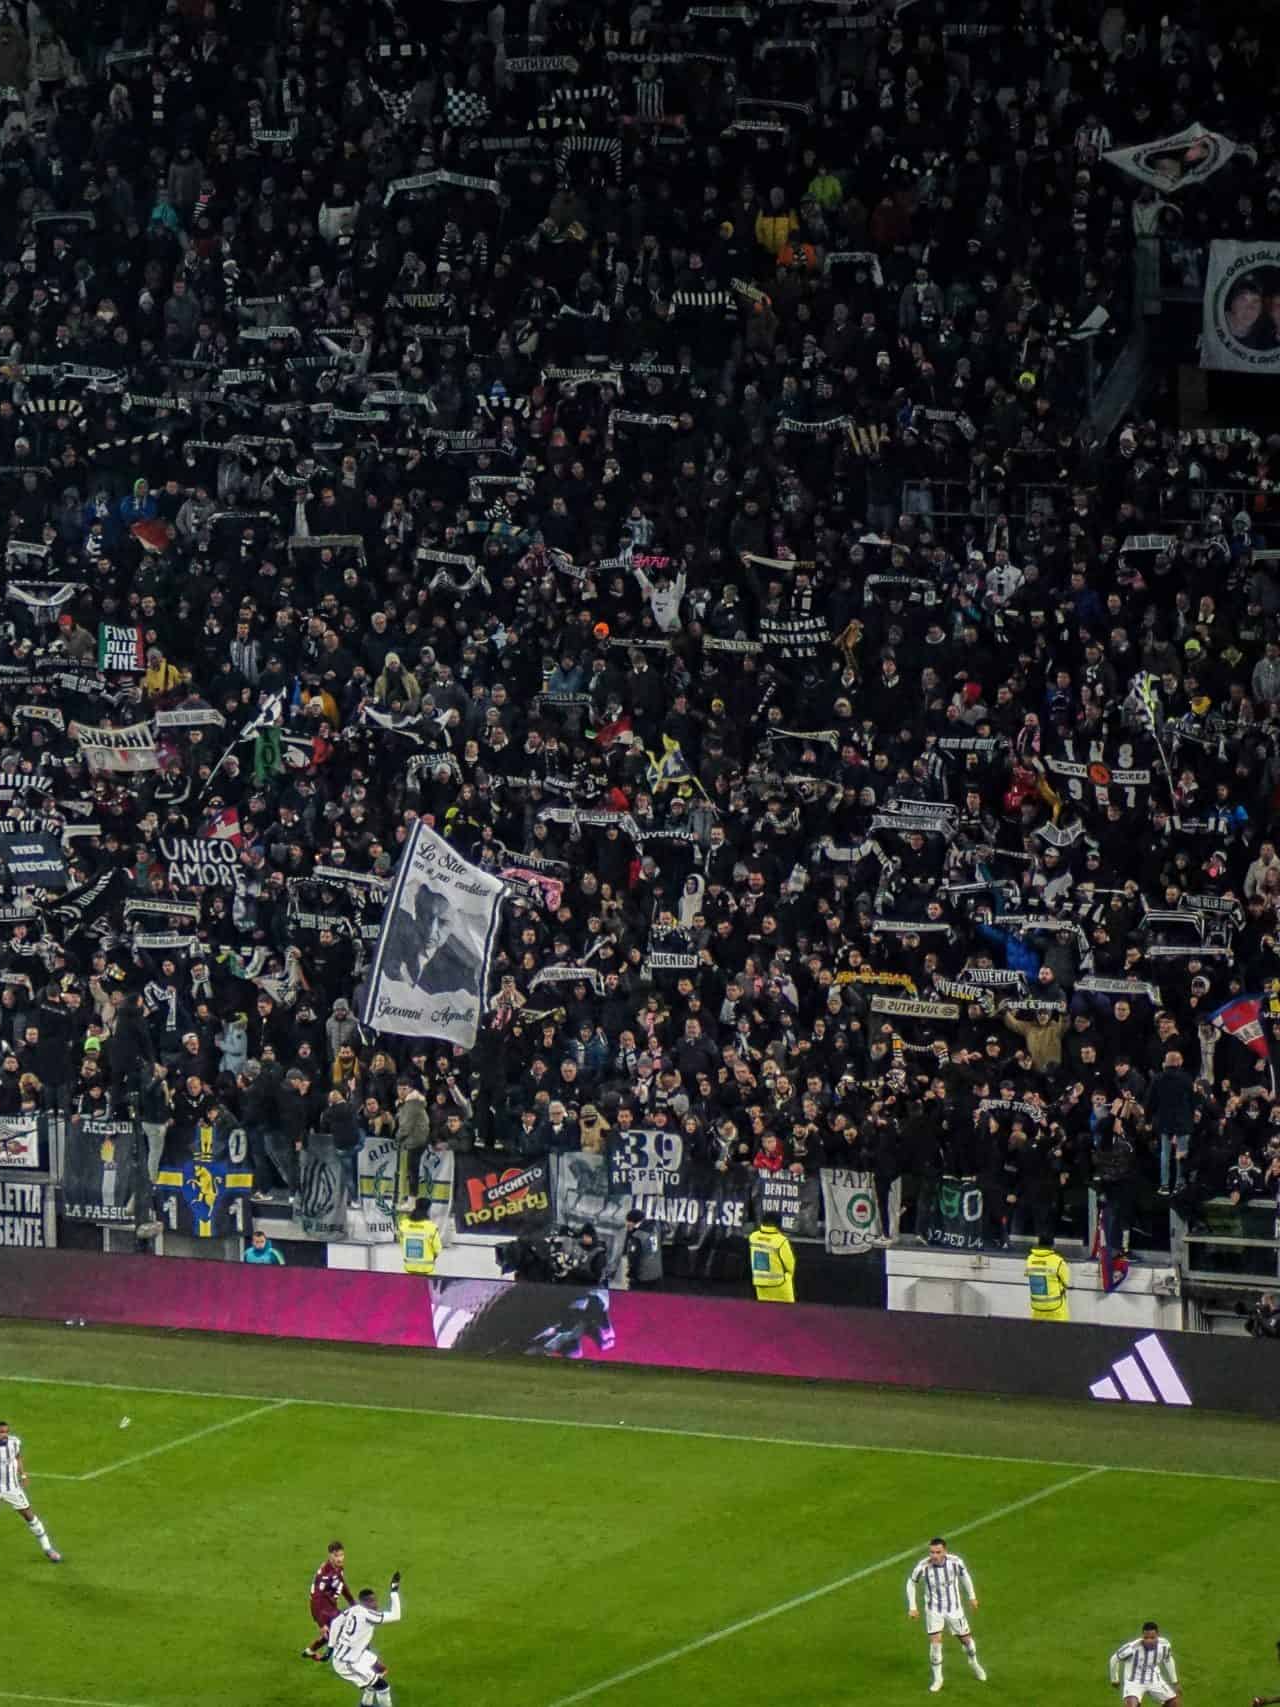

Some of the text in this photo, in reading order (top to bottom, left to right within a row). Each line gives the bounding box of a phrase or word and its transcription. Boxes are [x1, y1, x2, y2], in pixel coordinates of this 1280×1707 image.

[760, 616, 825, 631] SEMPRE
[103, 624, 138, 641] FINO
[761, 632, 830, 647] INSIEME
[105, 642, 138, 654] ALLA
[780, 647, 817, 659] A TE
[103, 655, 140, 671] FINE
[161, 838, 236, 865] UNICO
[169, 865, 244, 888] AMORE
[648, 953, 697, 968] JUVENTUS
[970, 970, 1019, 985] JUVENTUS
[936, 978, 982, 1001] JUVENTUS
[377, 997, 423, 1021] Giovanni
[83, 1121, 133, 1135] ACCENDI
[228, 1128, 246, 1164] 0
[487, 1167, 543, 1201] CICCHETTO
[612, 1168, 680, 1186] RISPETTO
[763, 1183, 799, 1198] DENTRO
[64, 1204, 80, 1218] LA
[163, 1196, 178, 1231] 1
[492, 1191, 549, 1222] party
[228, 1198, 244, 1233] 1
